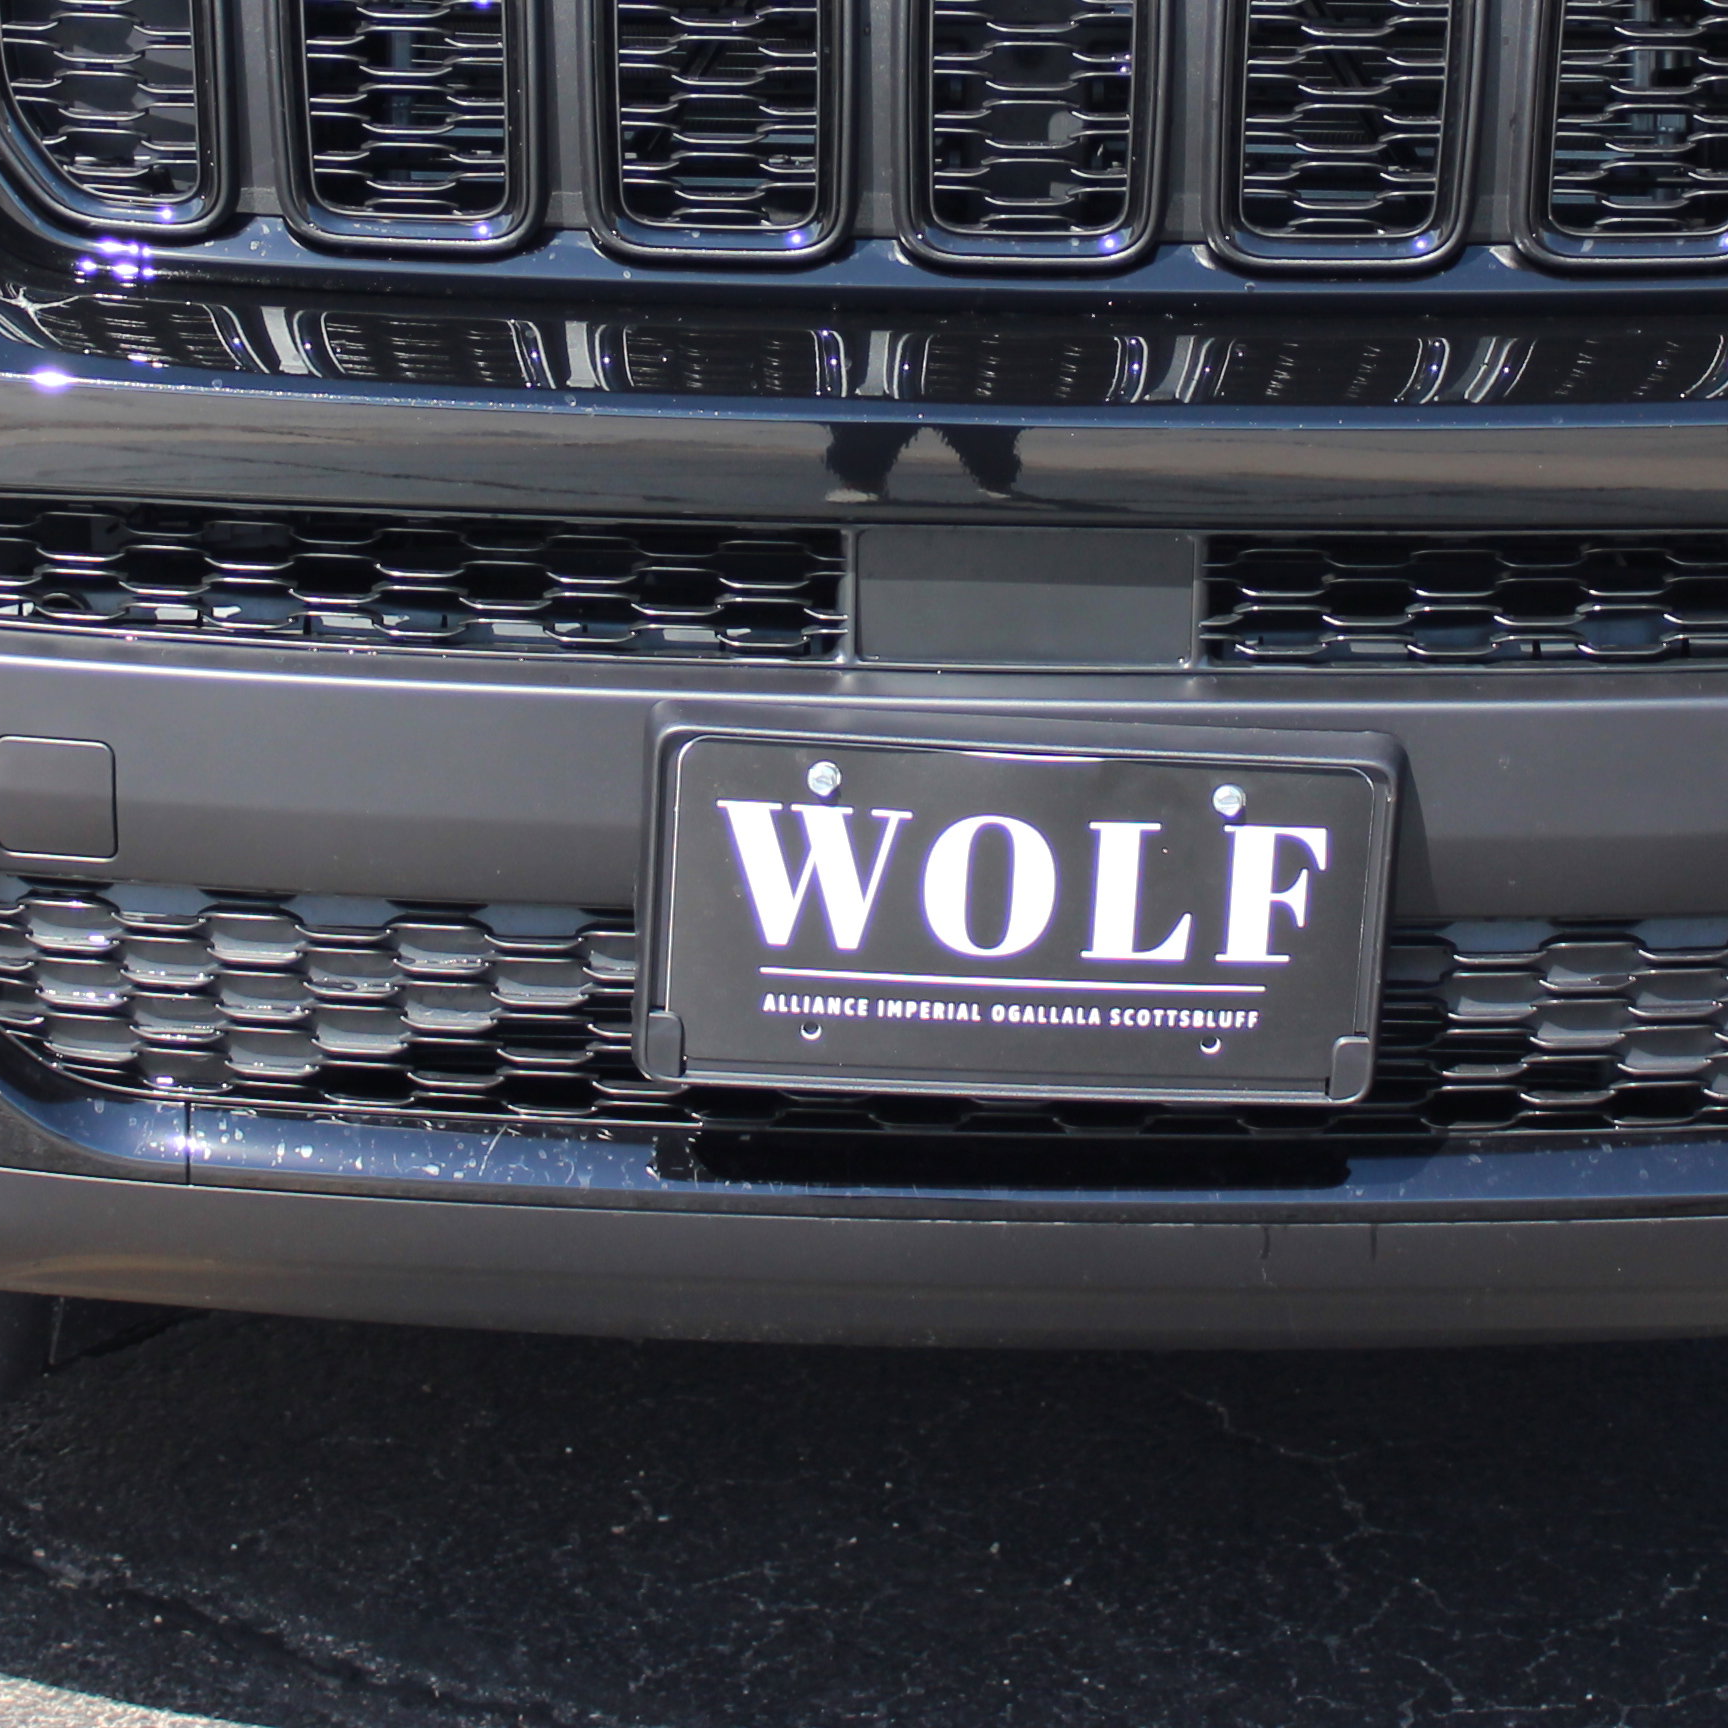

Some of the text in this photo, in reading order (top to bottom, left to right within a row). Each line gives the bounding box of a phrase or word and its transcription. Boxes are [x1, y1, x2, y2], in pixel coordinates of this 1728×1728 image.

[715, 799, 1328, 964] WOLF
[762, 993, 1259, 1029] ALLIANCE IMPERIAL OGALLALA SCOTTSBLUFF
